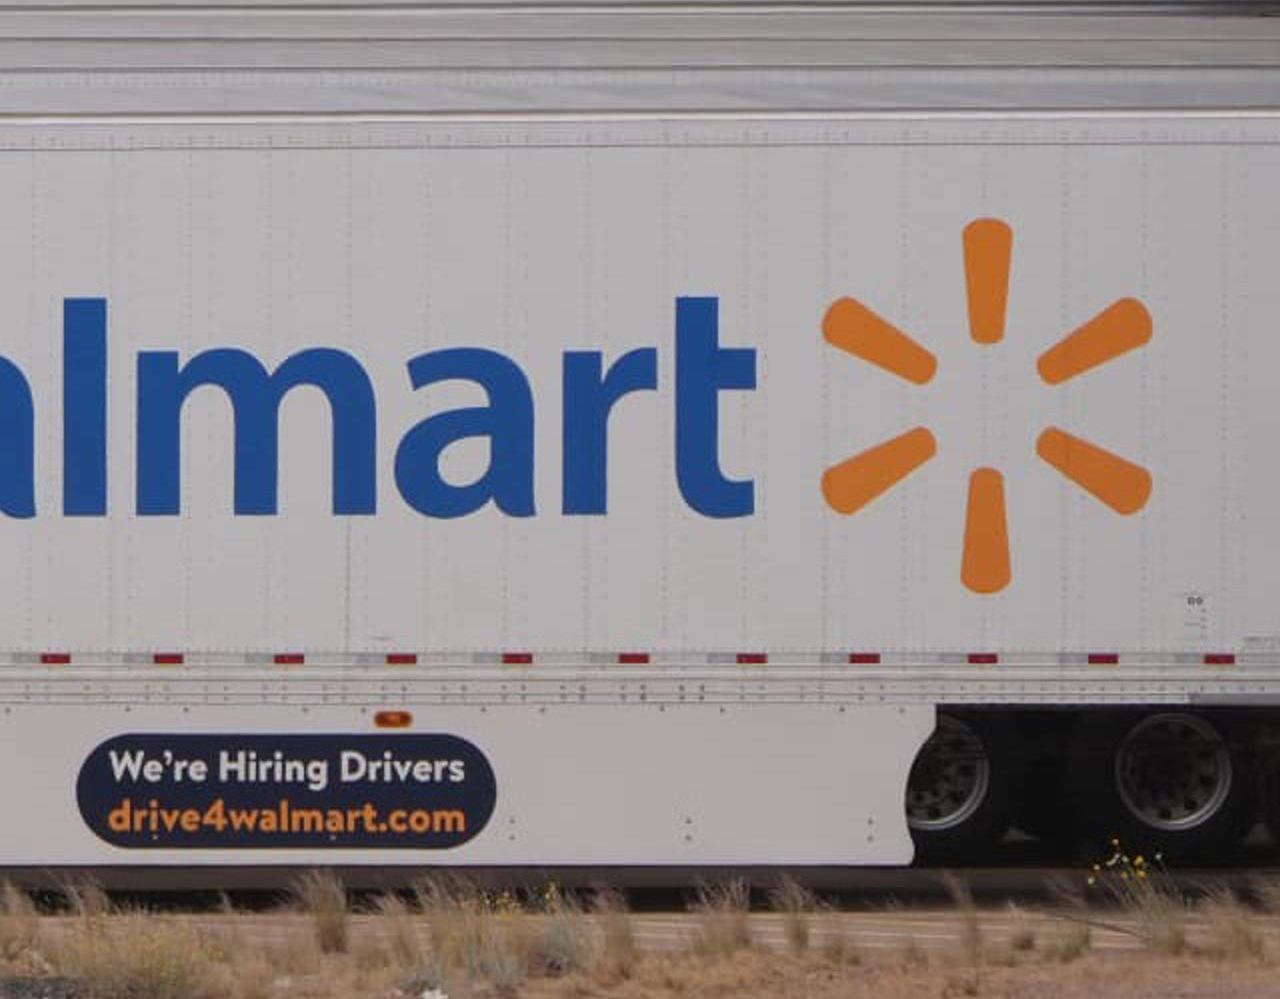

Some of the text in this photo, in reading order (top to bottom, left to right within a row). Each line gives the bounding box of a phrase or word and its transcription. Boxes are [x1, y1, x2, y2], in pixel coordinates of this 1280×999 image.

[109, 750, 466, 791] We're Hiring Drivers
[107, 798, 466, 834] drive4walmart.com
